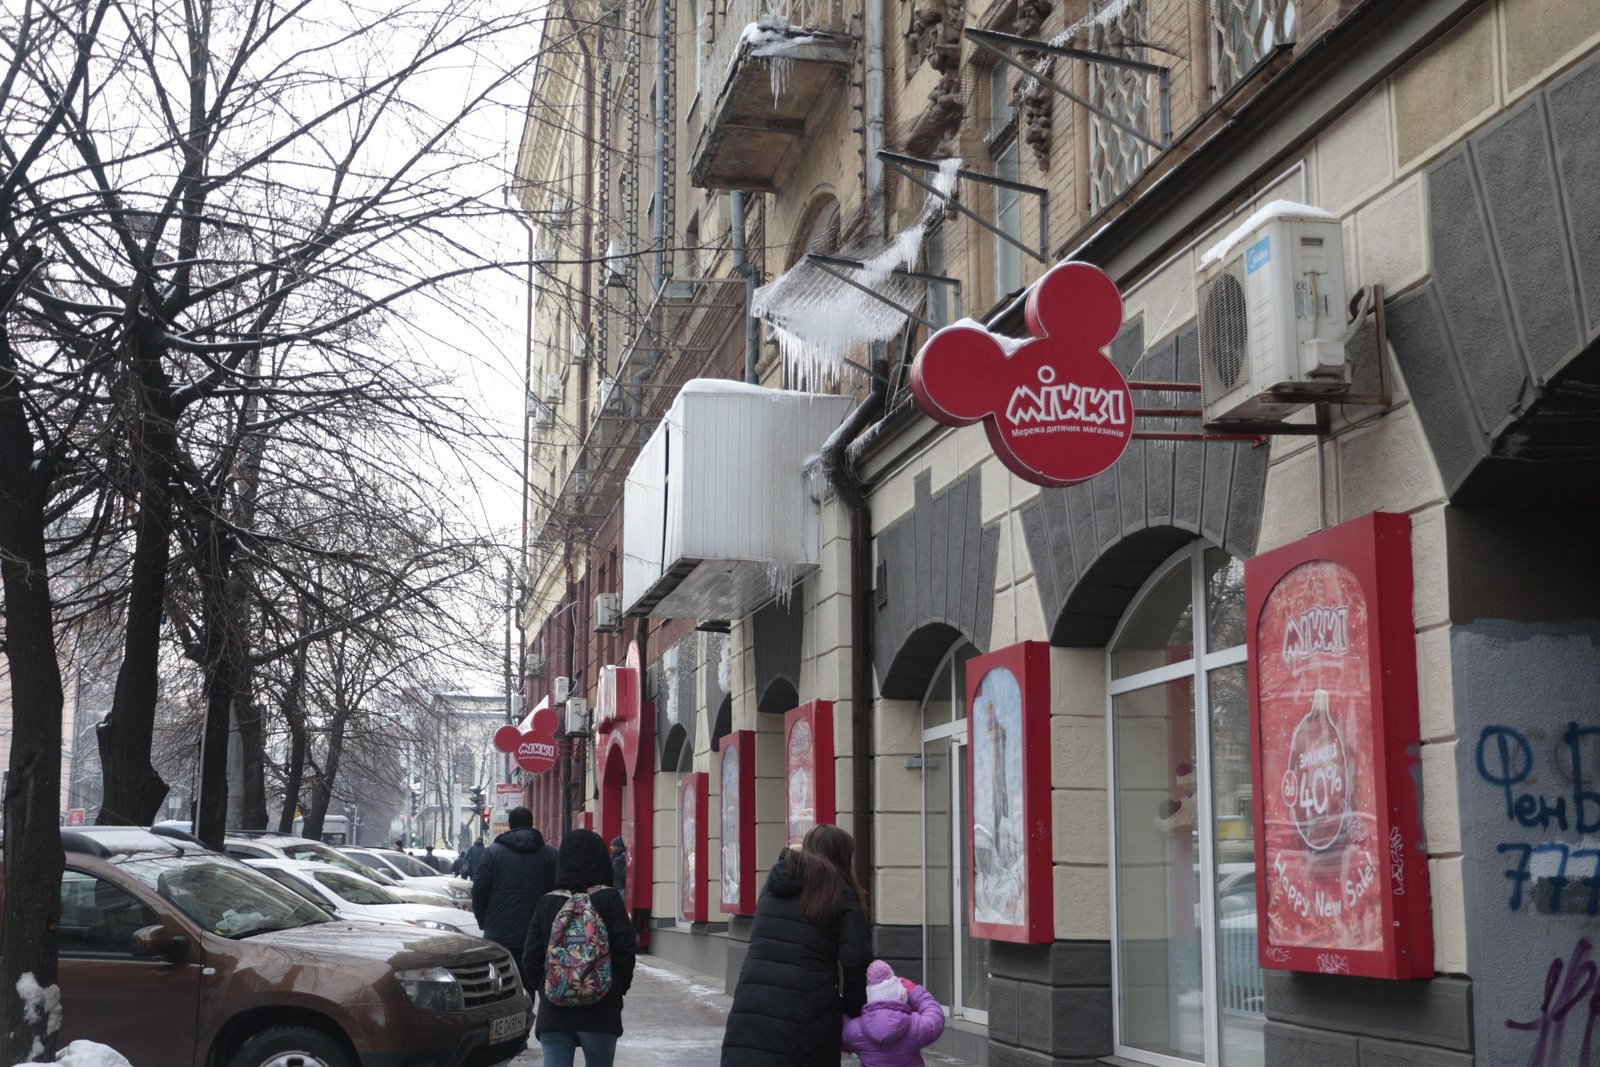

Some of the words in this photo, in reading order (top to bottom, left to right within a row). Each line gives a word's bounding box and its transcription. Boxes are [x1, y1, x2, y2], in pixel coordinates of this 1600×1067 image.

[1011, 426, 1045, 438] Мережа
[1046, 425, 1080, 434] дитячих
[1082, 426, 1125, 438] магазинів
[1299, 763, 1342, 818] 40%
[1273, 852, 1310, 918] Happy
[1315, 890, 1342, 918] New
[1345, 851, 1377, 907] Sale!
